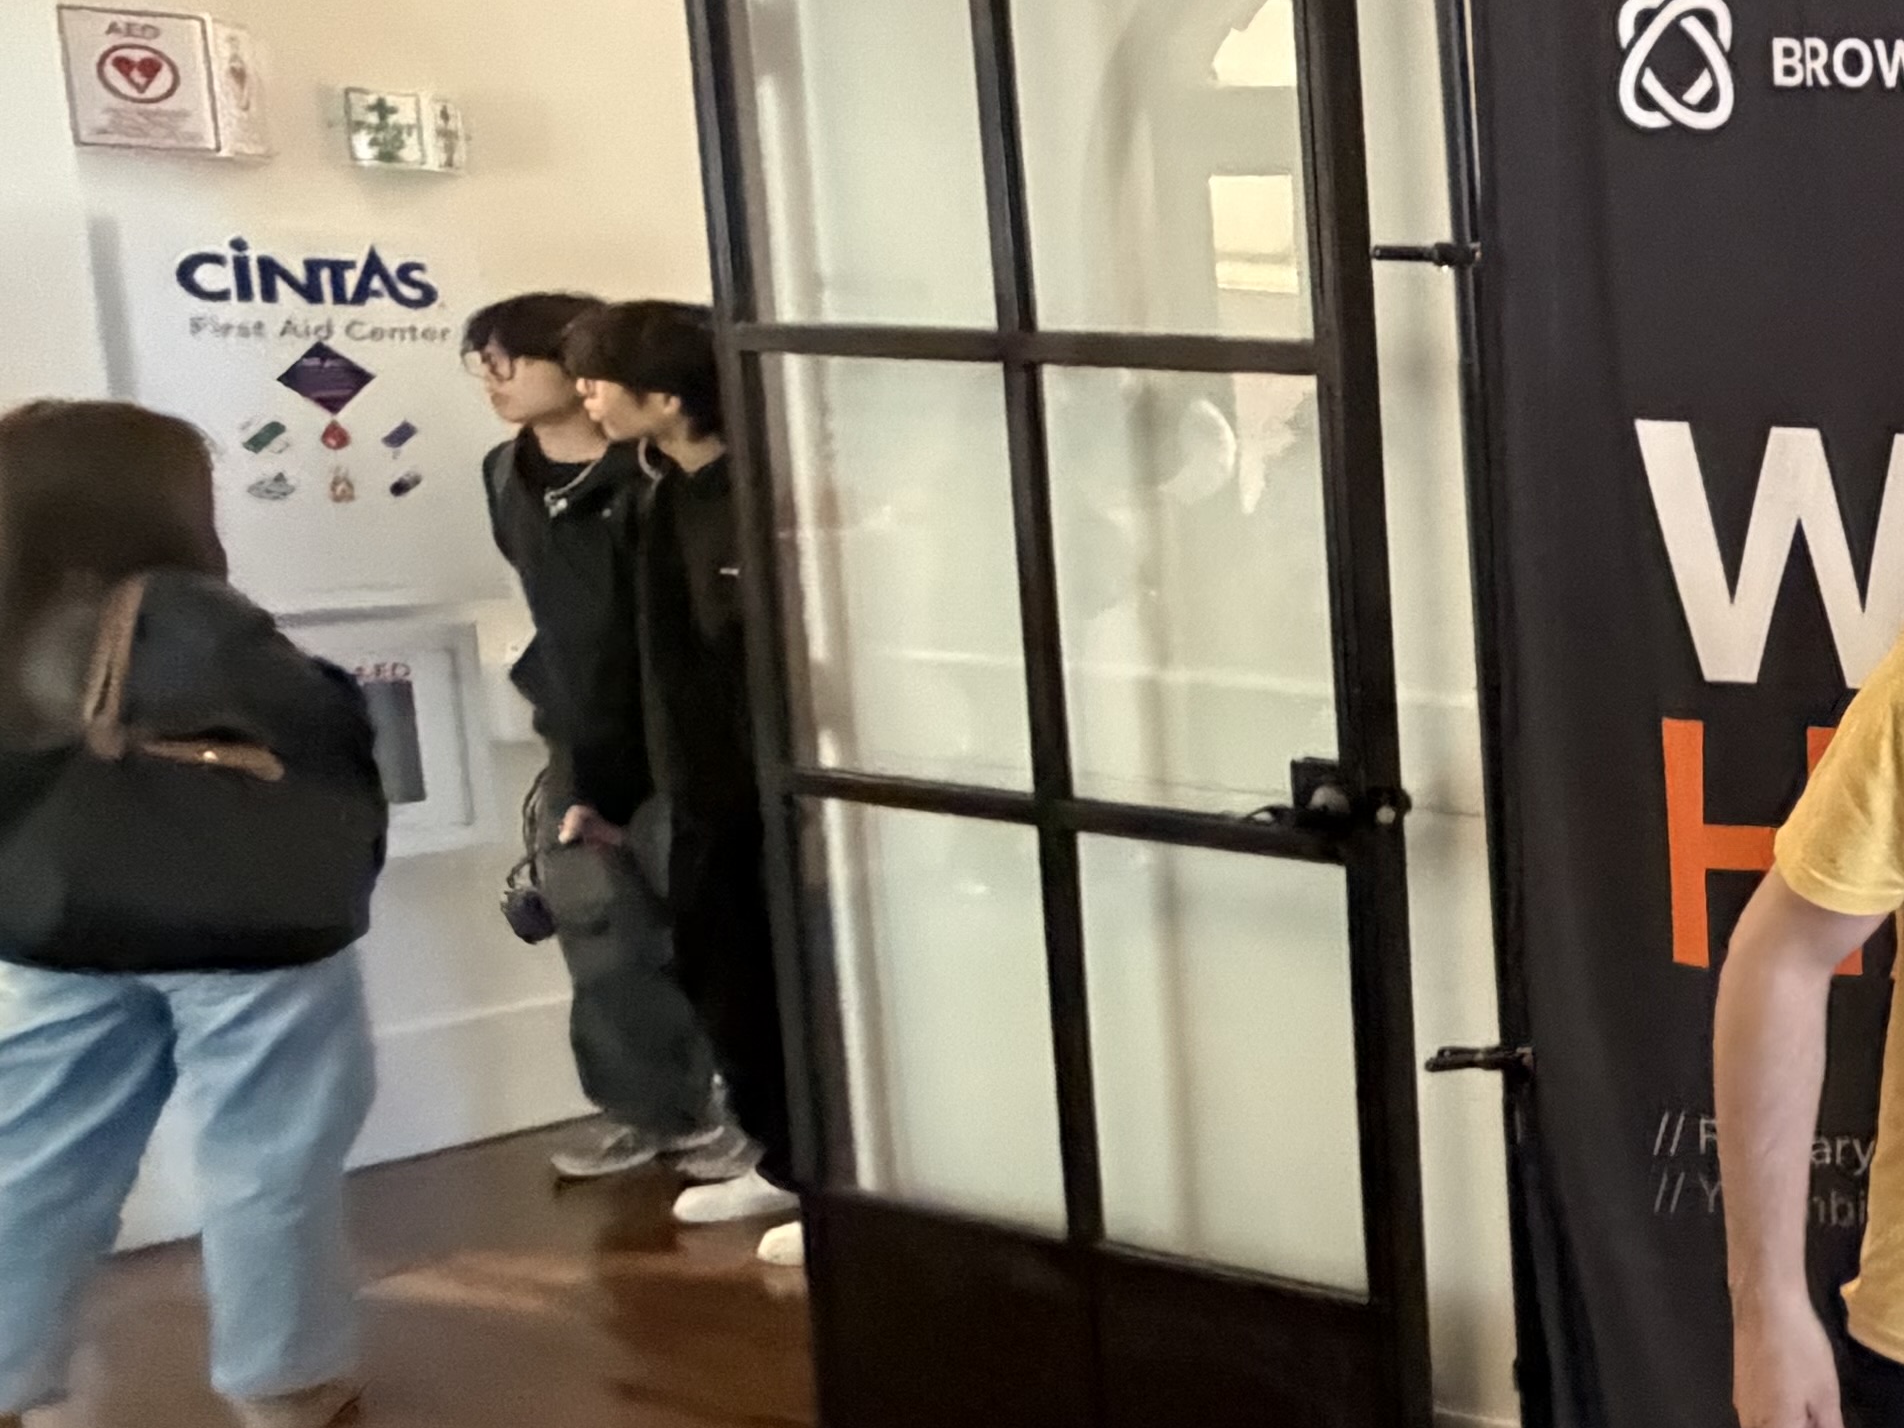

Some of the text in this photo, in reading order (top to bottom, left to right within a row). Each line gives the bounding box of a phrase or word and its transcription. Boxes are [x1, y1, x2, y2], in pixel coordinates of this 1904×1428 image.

[105, 21, 160, 39] AED
[189, 317, 452, 342] First Aid Center
